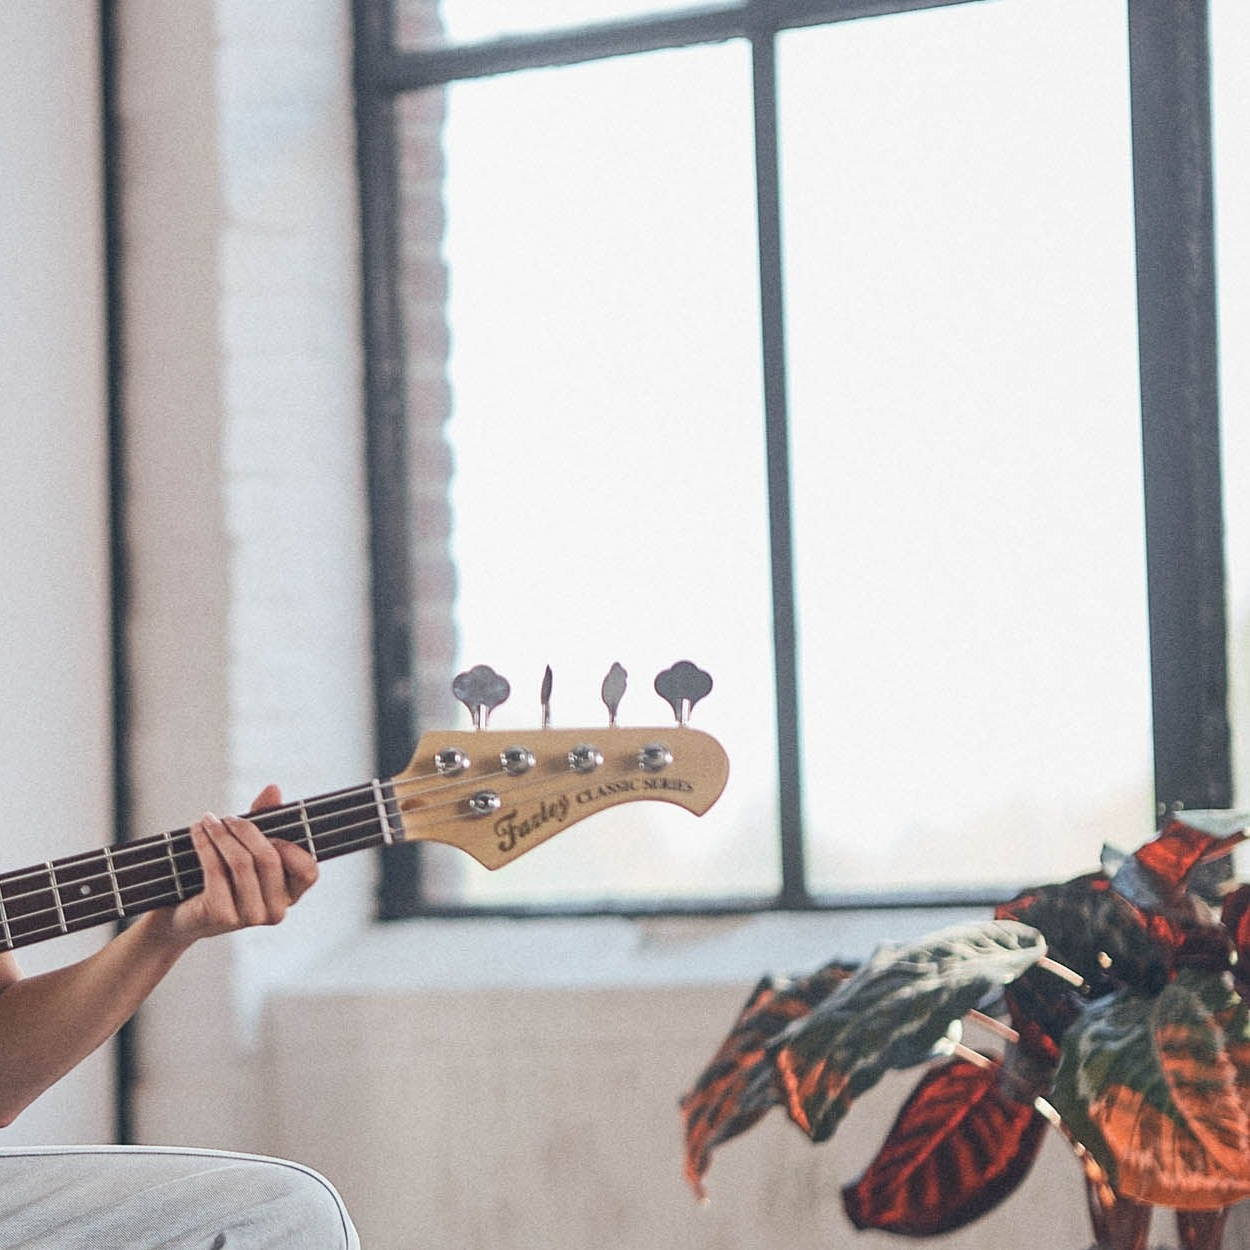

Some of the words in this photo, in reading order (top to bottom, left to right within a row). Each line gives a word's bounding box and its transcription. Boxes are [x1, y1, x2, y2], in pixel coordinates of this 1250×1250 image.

[493, 793, 570, 852] Fazley
[576, 779, 636, 804] CLASSIC
[644, 776, 694, 793] SERIES
